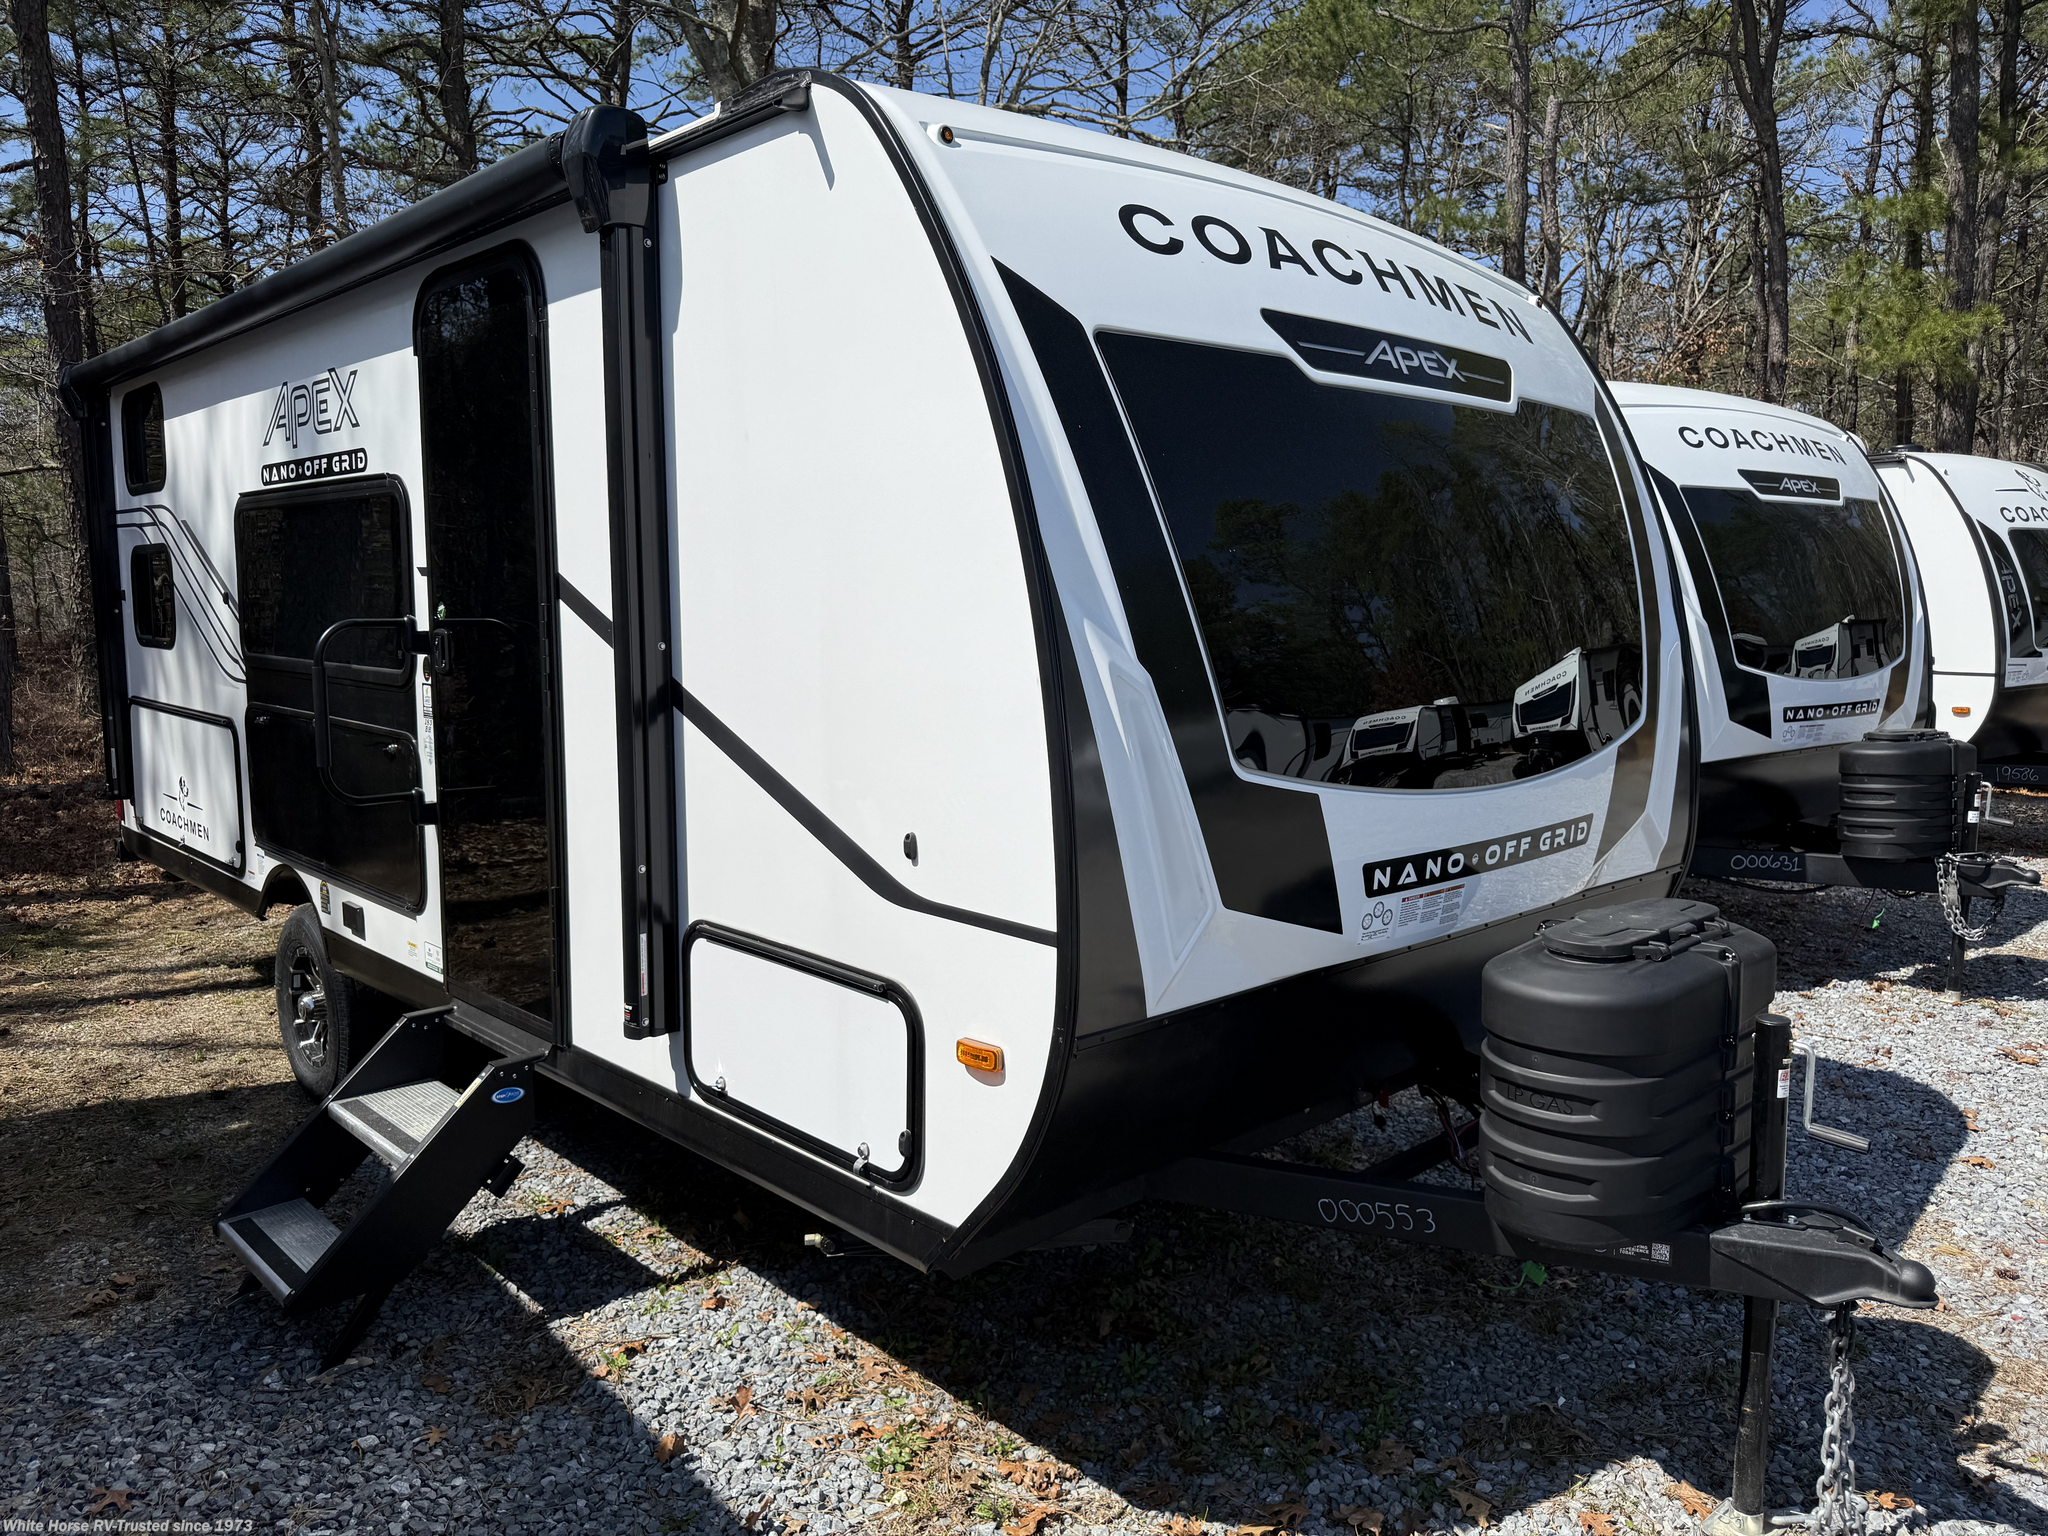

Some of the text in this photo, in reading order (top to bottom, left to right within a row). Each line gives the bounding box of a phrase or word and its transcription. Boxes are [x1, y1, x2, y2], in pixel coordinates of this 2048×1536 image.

[1118, 203, 1534, 345] COACHMEN
[1364, 339, 1467, 383] APEX
[262, 367, 361, 450] APEX
[1678, 426, 1848, 466] COACHMEN
[262, 451, 366, 483] NANO OFF GRID
[1779, 477, 1822, 494] APEX
[1994, 550, 2023, 633] APEX
[1786, 702, 1878, 720] NANO OFF GRID
[1996, 766, 2039, 782] 19586
[160, 807, 210, 842] COACHMEN
[1373, 821, 1588, 891] NANO OFF GRID
[1730, 854, 1803, 872] 000631
[1506, 1084, 1574, 1115] LP GAS
[1318, 1198, 1436, 1233] 000553
